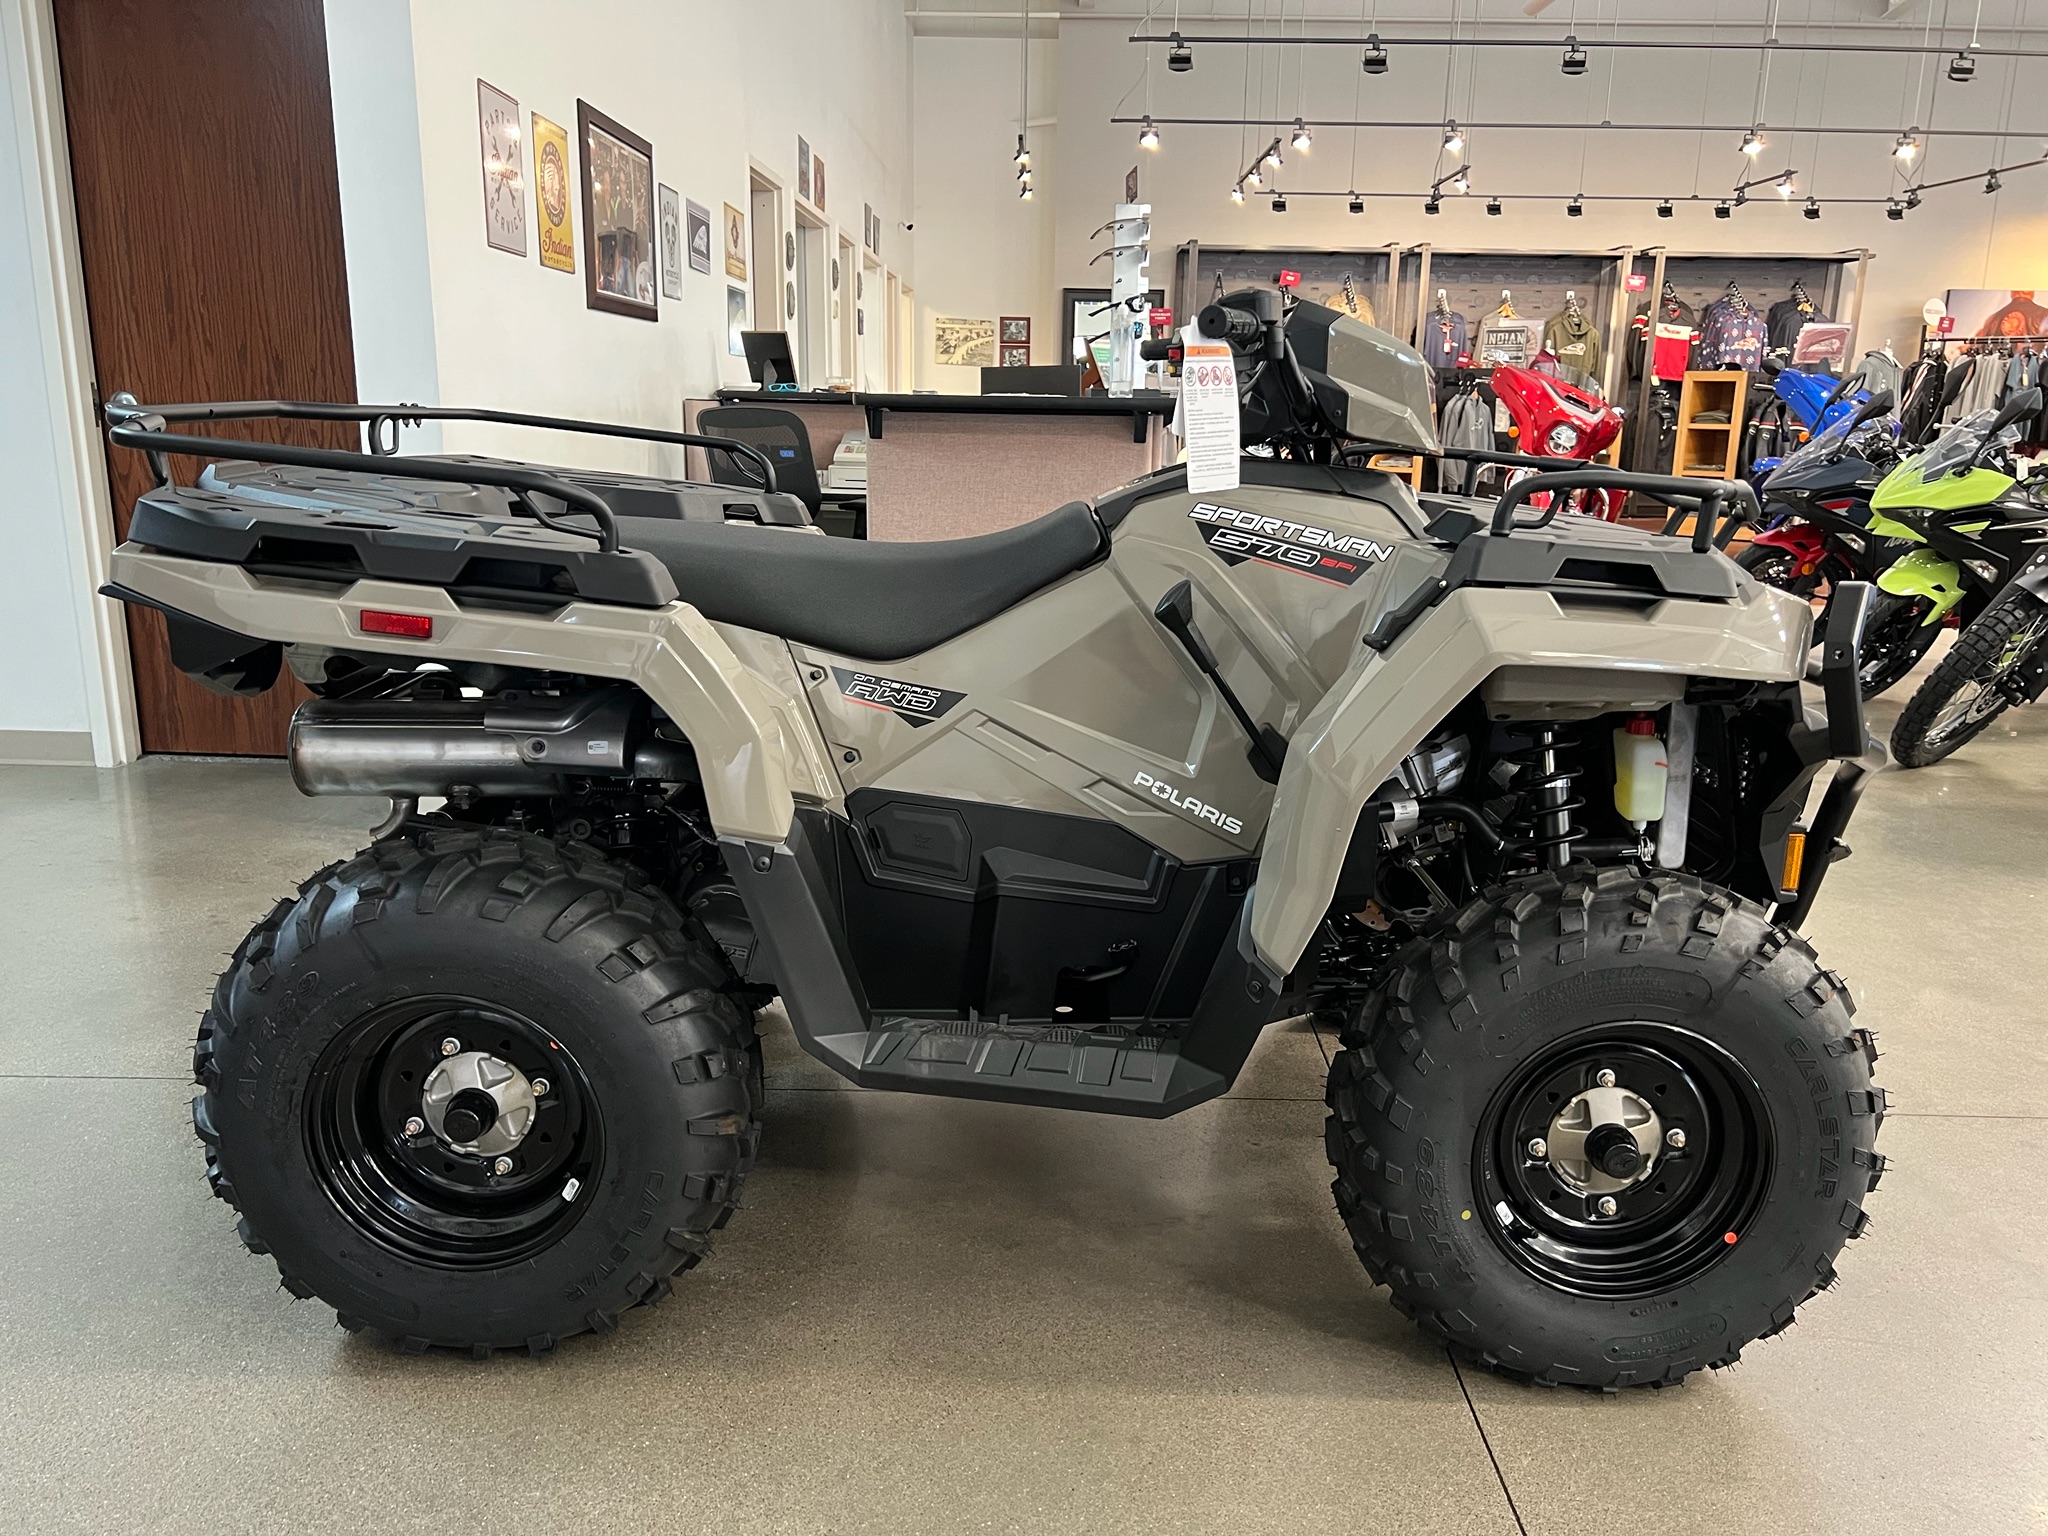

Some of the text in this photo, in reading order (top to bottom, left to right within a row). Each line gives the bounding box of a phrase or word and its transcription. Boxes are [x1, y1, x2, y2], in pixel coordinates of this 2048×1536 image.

[543, 227, 573, 259] Indian
[1485, 332, 1525, 345] INDIAN
[1188, 502, 1395, 562] SPORTSMAN
[1209, 528, 1357, 573] 570 EFI
[845, 681, 937, 711] AWD
[854, 674, 941, 697] ON DEMAND
[1133, 770, 1243, 834] POLARIS
[237, 970, 319, 1110] AT489
[1784, 1037, 1843, 1203] CARLSTAR
[562, 1170, 665, 1303] CARLSTAR
[1417, 1136, 1475, 1281] AT489
